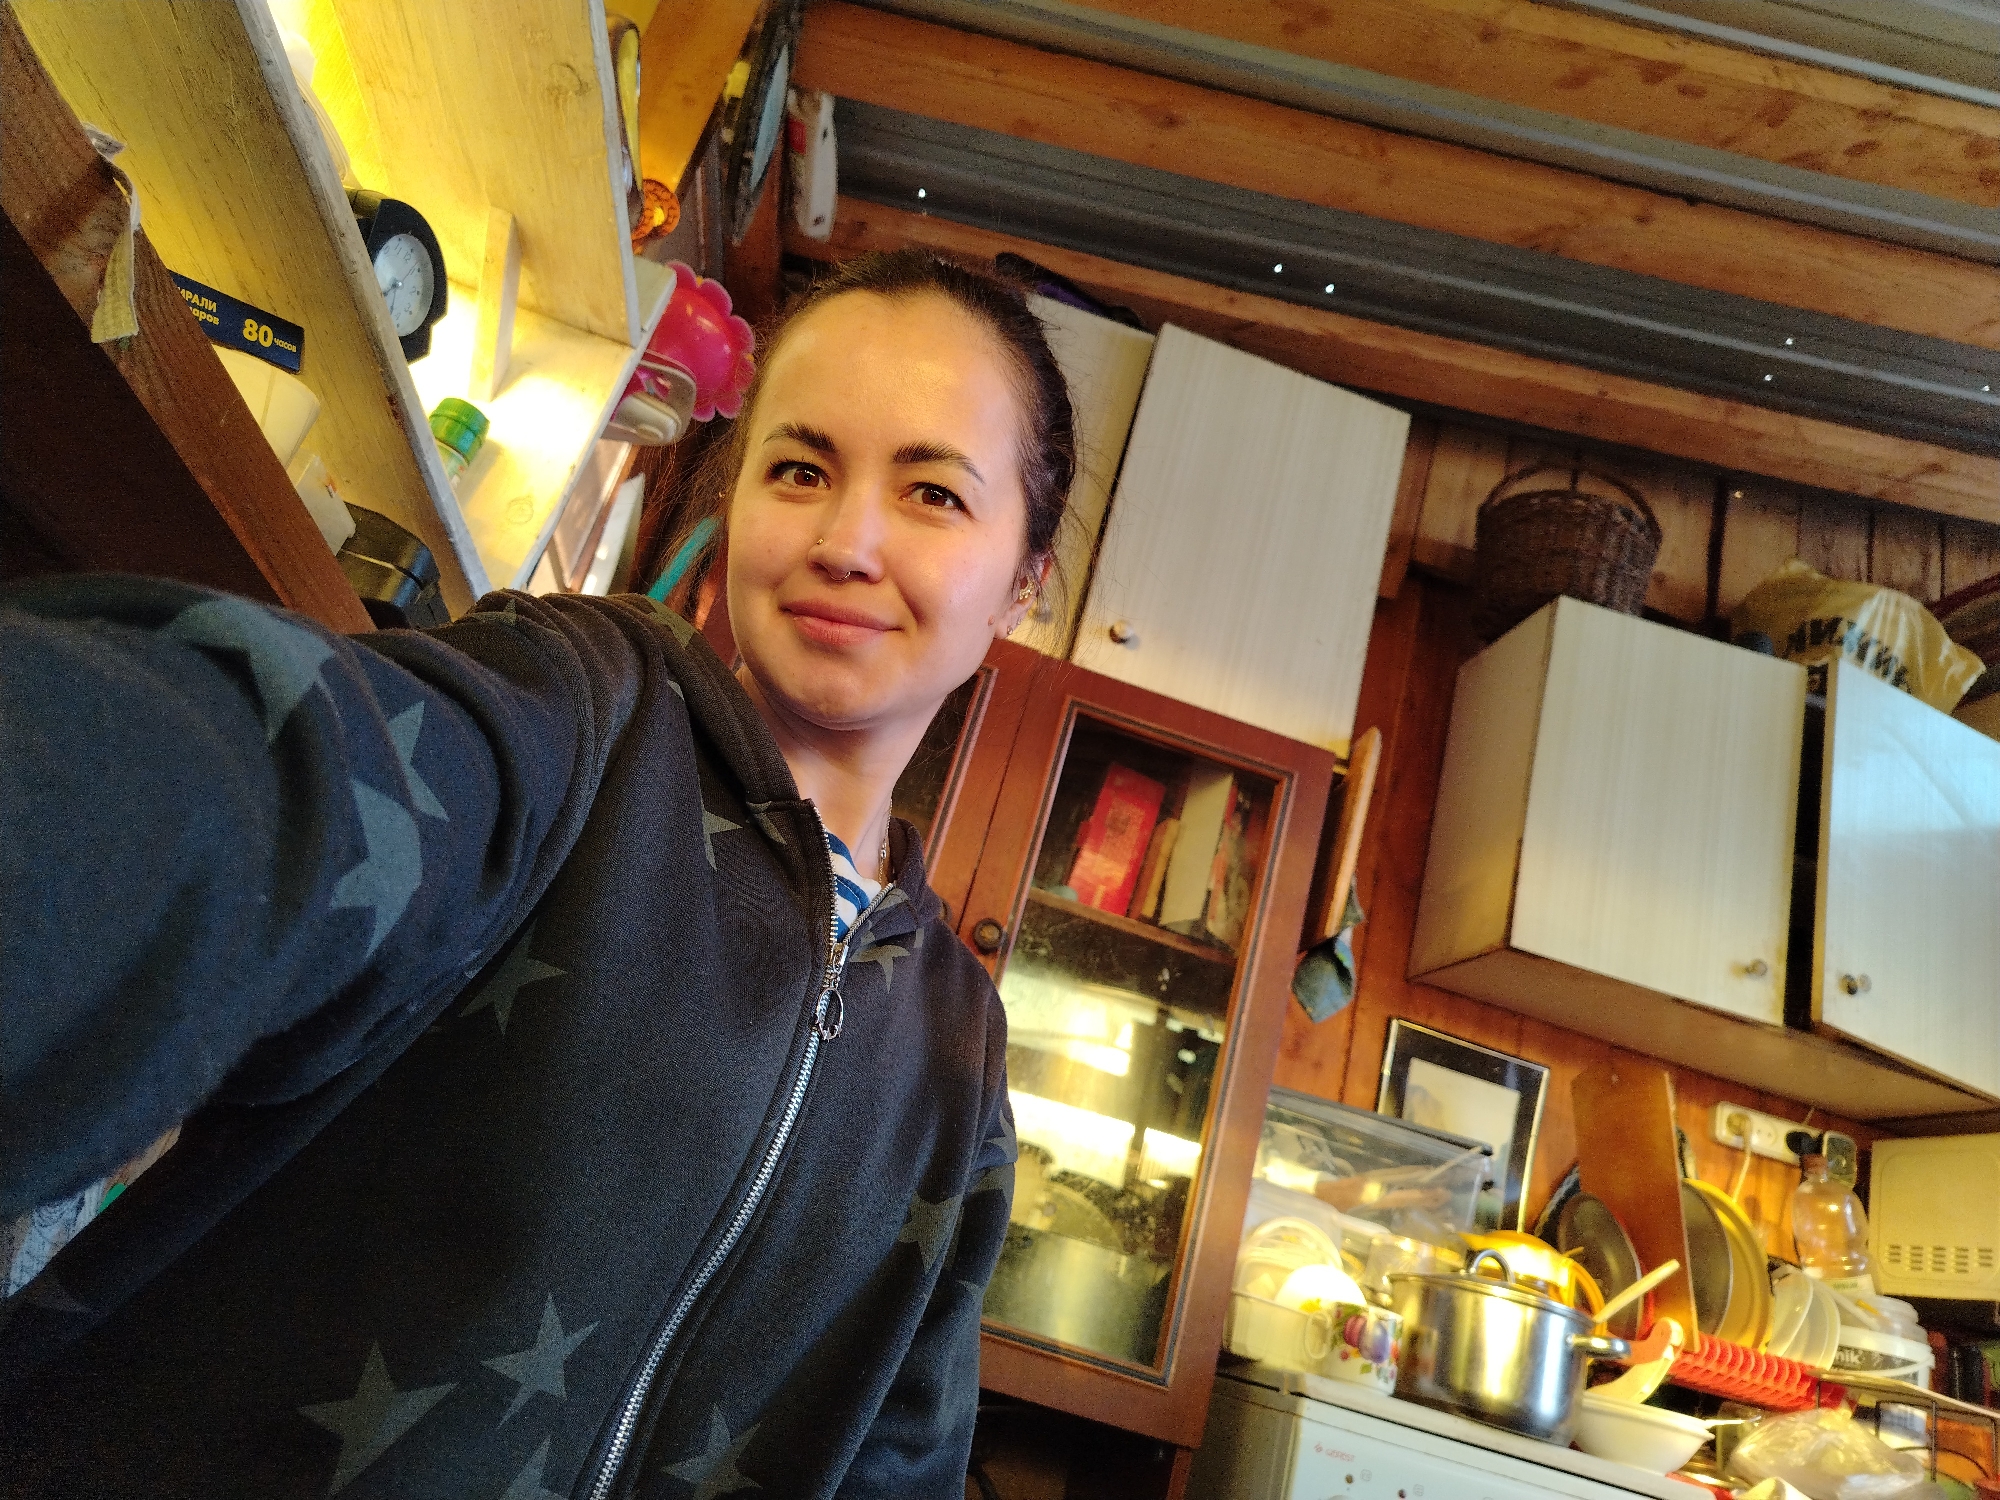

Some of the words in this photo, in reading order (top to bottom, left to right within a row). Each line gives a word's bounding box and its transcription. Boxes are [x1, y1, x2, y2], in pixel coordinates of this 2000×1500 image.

[190, 306, 220, 326] аров
[242, 318, 274, 348] 80
[273, 337, 297, 353] часов
